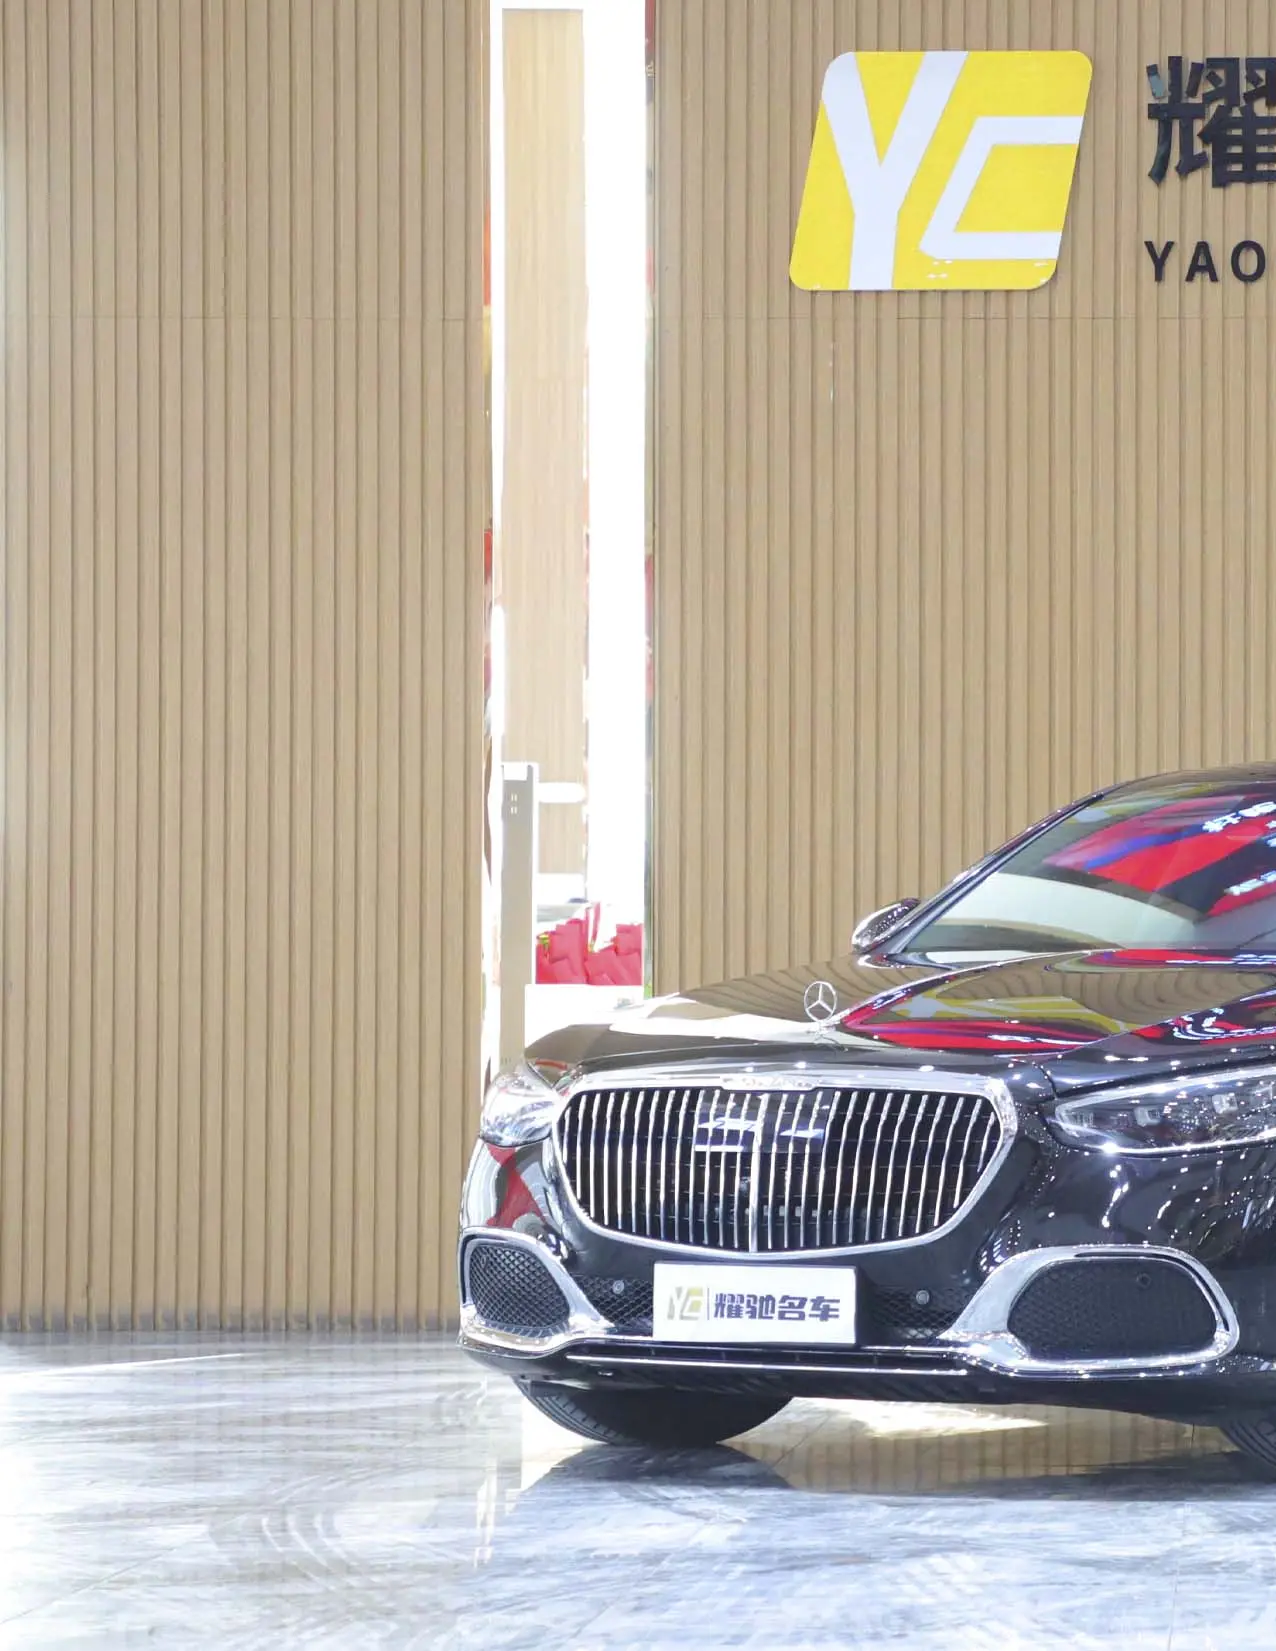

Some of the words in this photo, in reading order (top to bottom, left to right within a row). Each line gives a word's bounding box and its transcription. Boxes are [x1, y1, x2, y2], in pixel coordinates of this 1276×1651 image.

[820, 50, 1083, 290] YC
[714, 1293, 840, 1322] 耀驰名车
